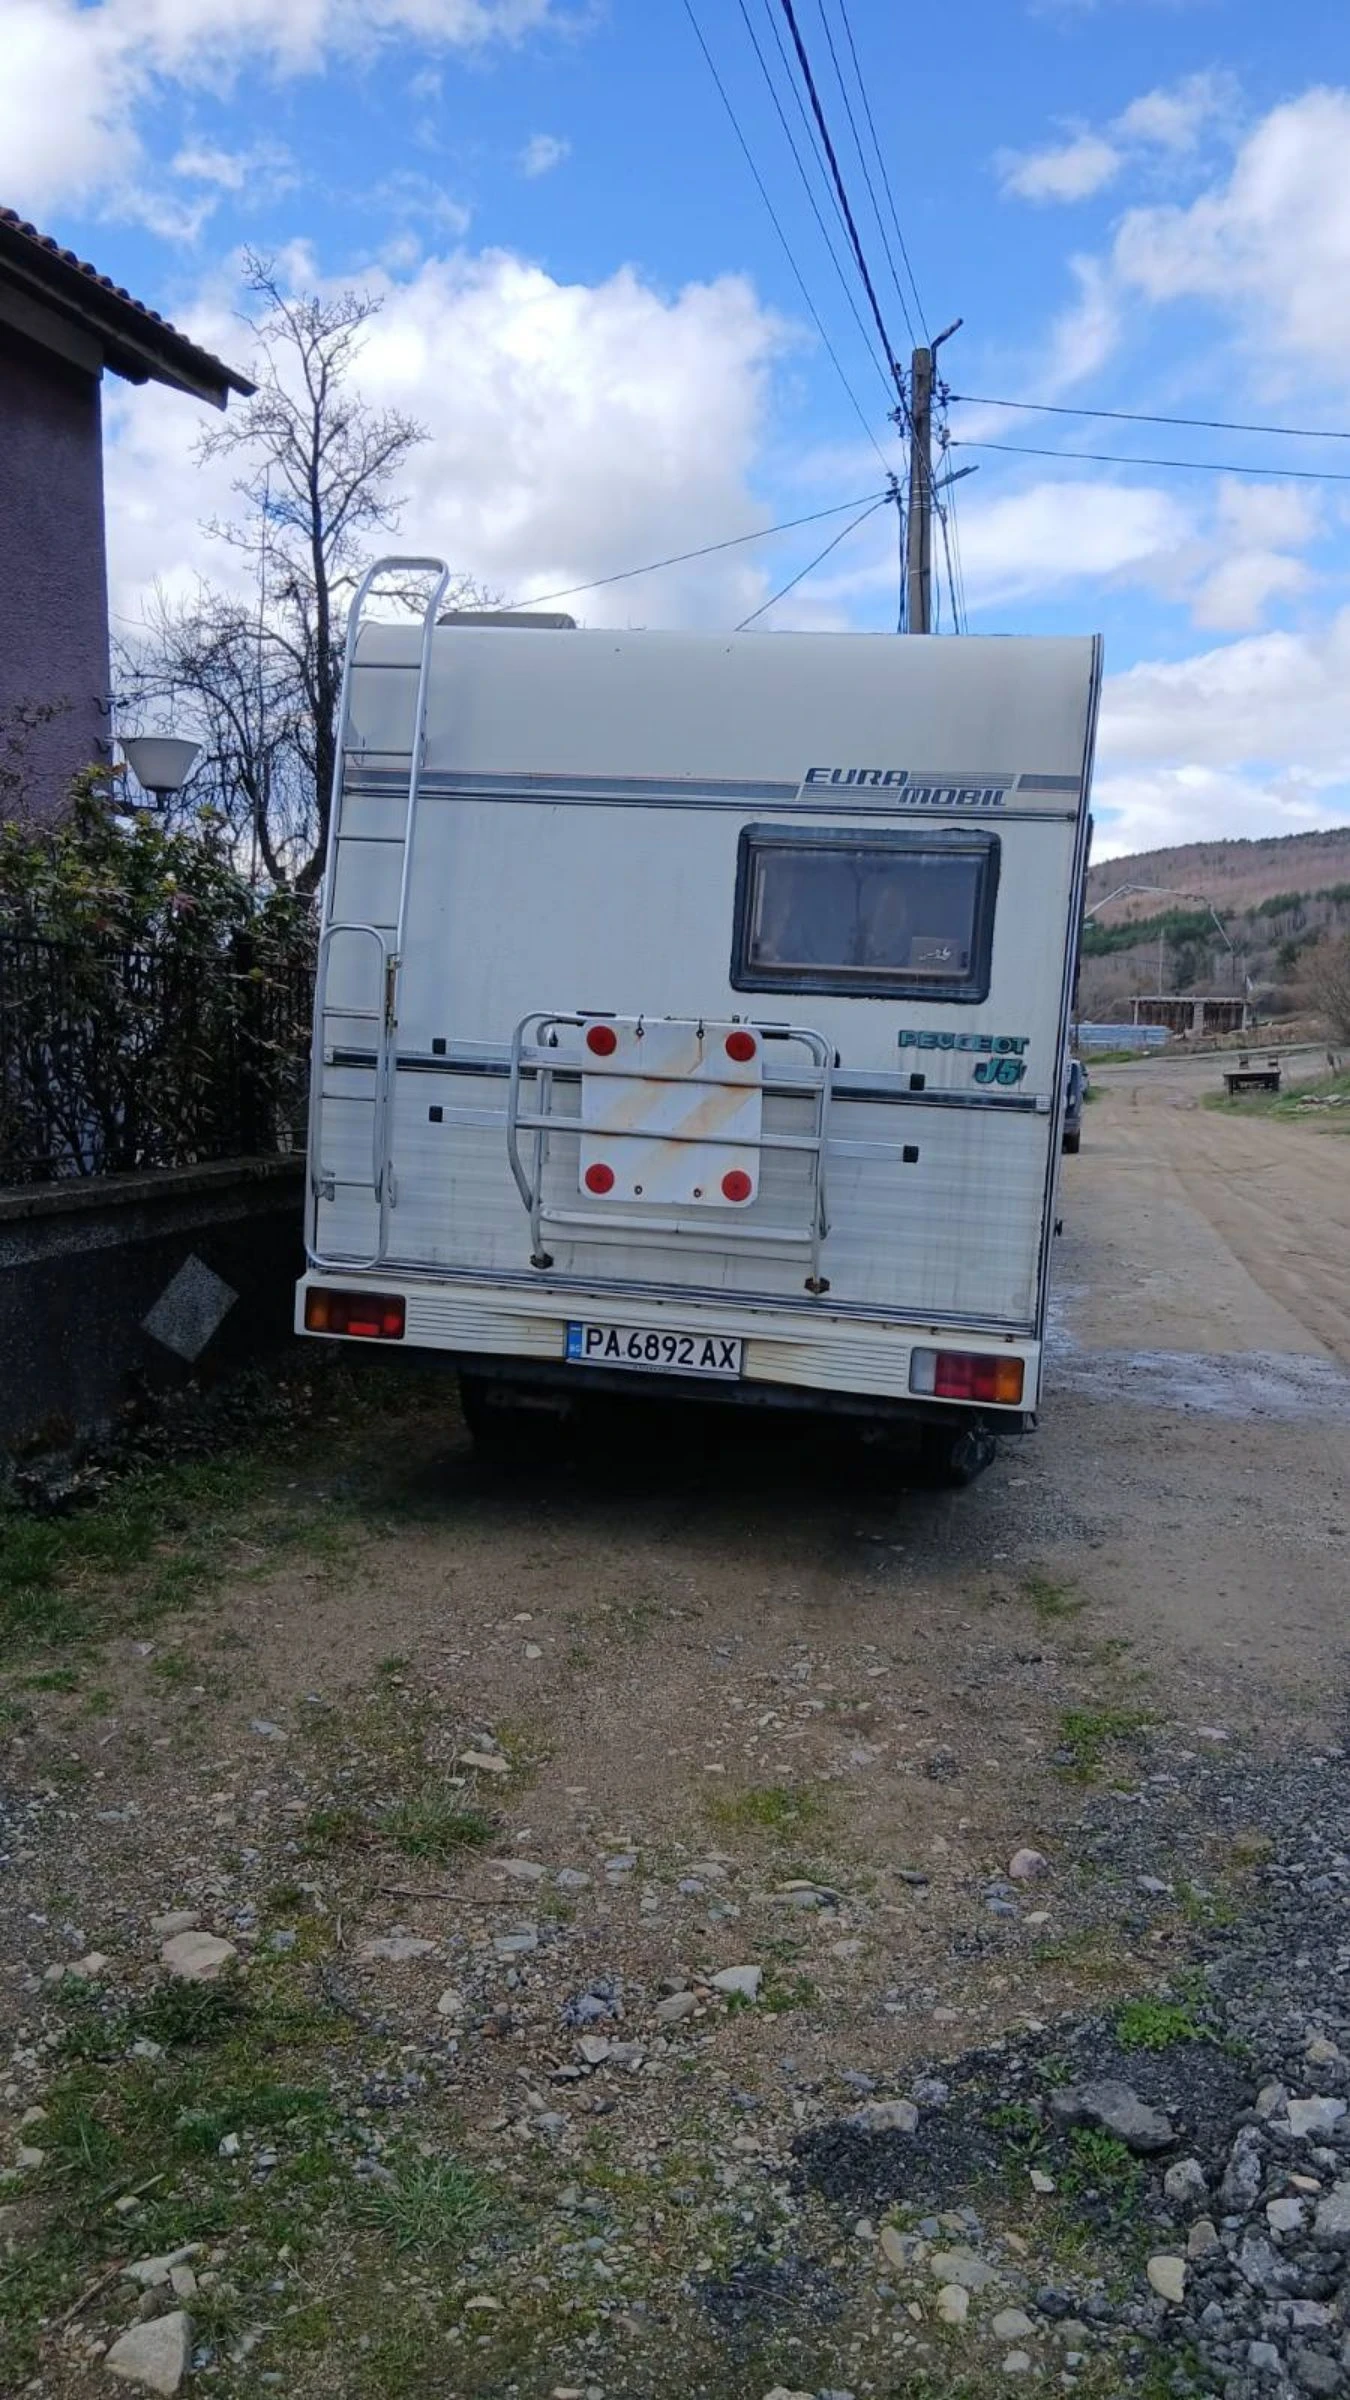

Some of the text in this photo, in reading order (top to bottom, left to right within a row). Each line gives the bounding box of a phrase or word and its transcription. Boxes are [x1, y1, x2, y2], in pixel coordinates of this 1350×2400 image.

[805, 768, 908, 785] EURA
[900, 788, 1006, 806] MOBIL
[898, 1030, 1030, 1055] PEUGEOT
[974, 1058, 1027, 1085] J5
